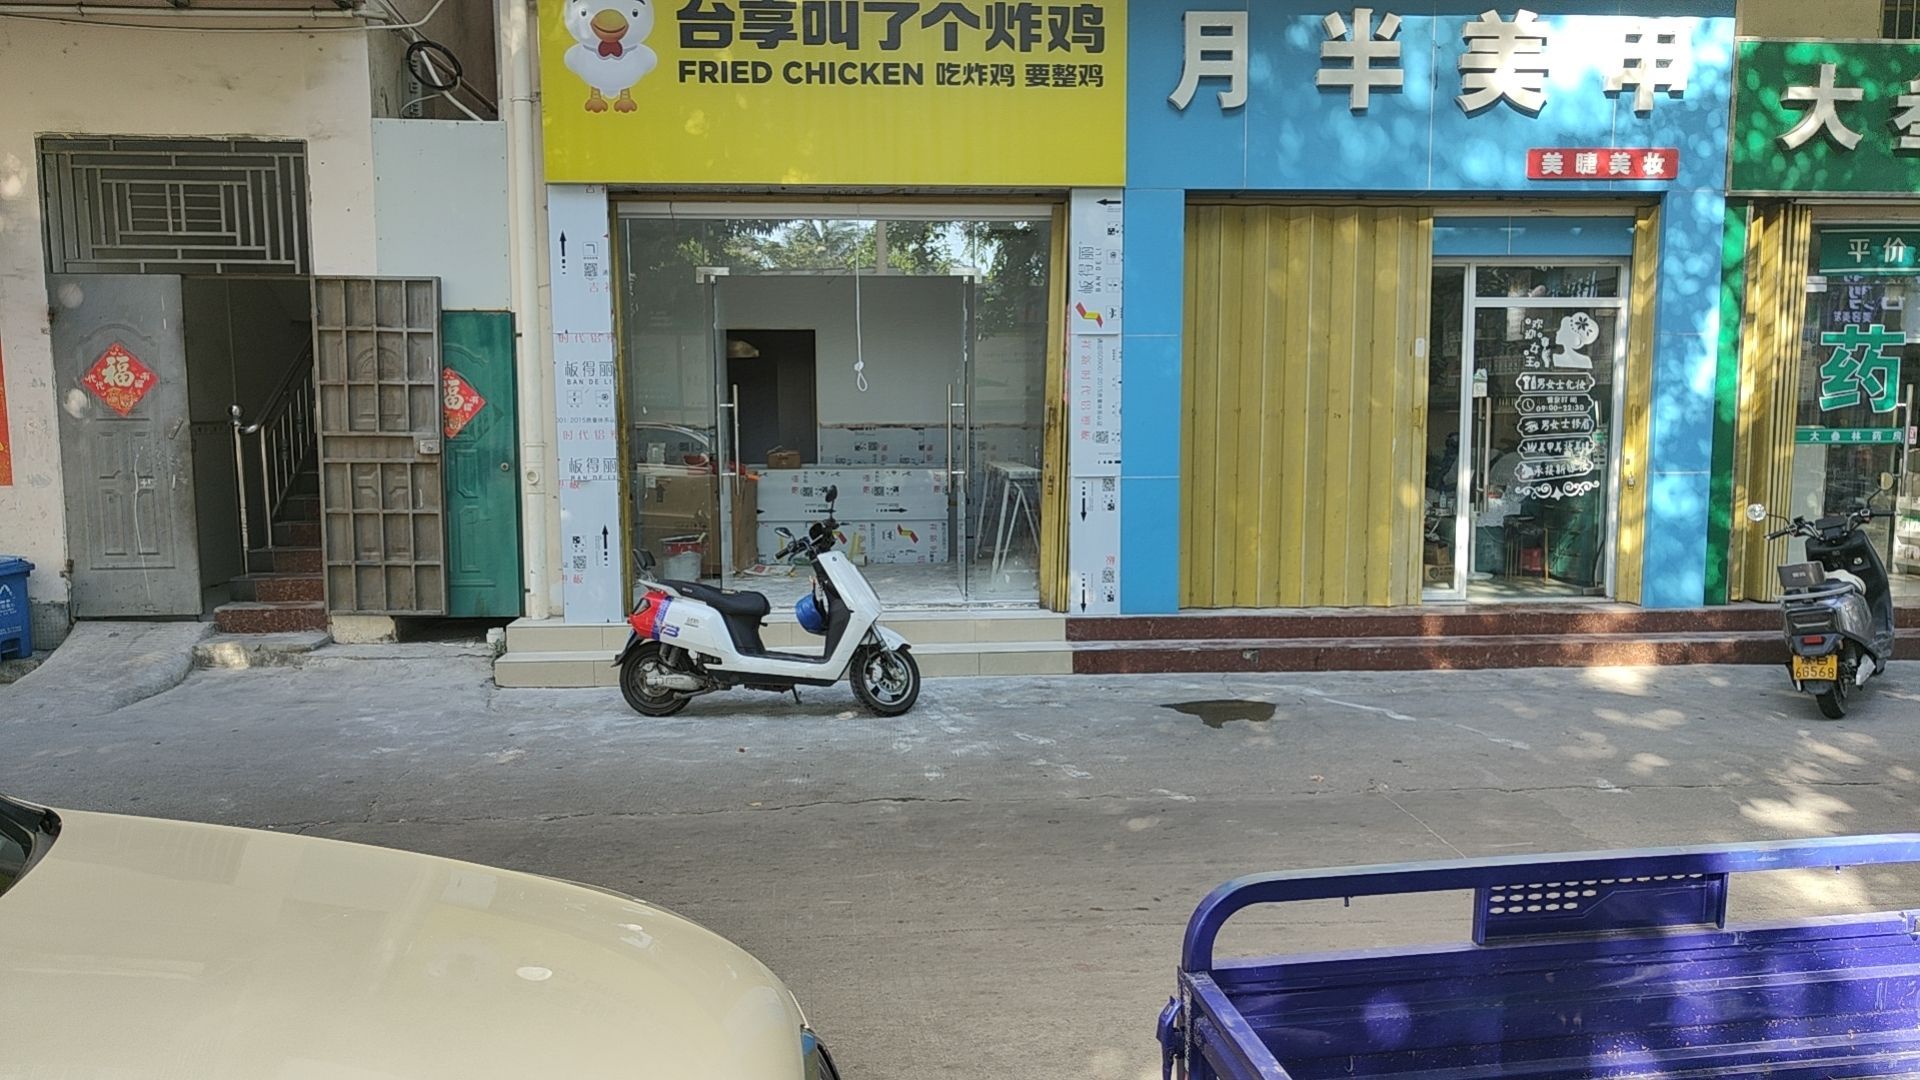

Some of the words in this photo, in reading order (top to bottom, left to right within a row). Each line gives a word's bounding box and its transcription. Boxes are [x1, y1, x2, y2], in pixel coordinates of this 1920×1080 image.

[679, 60, 773, 84] FRIED
[783, 60, 924, 85] CHICKEN
[1168, 8, 1690, 112] 月半美甲
[936, 62, 1016, 87] 吃炸鸡
[1025, 63, 1105, 87] 要整鸡
[1541, 152, 1666, 175] 美睫美妆
[1848, 237, 1920, 263] 平价
[102, 356, 135, 387] 福
[565, 361, 614, 378] 板得丽
[1819, 324, 1907, 413] 药
[1537, 378, 1587, 391] 男女士化妆
[569, 457, 617, 474] 板得丽
[1795, 666, 1835, 679] 66568
